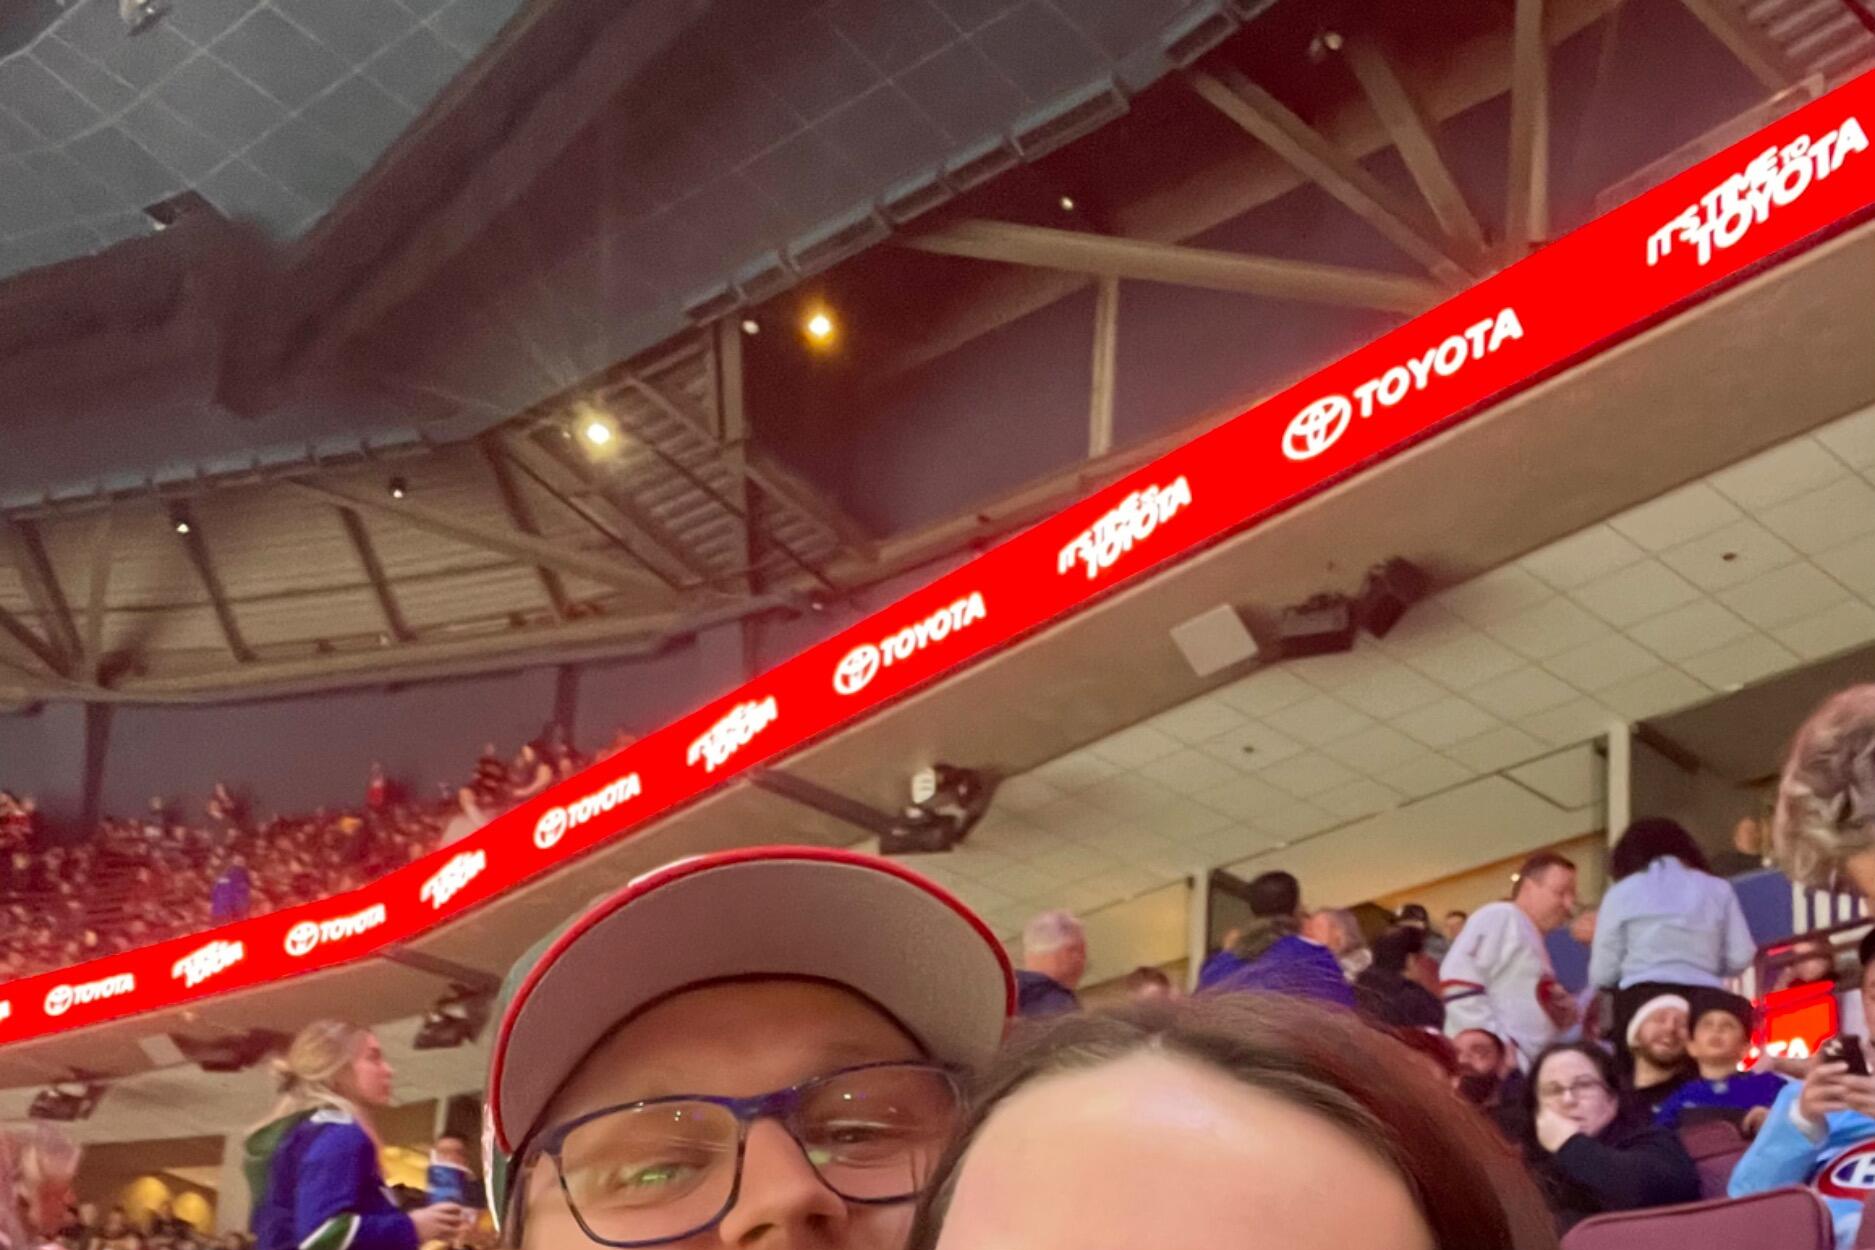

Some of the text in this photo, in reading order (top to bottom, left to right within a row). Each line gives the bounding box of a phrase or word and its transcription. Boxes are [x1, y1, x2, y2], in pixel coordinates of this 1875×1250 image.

[1697, 116, 1870, 267] TOYOTA
[1352, 307, 1525, 419] TOYOTA
[880, 591, 987, 668] TOYOTA
[567, 771, 642, 829] TOYOTA
